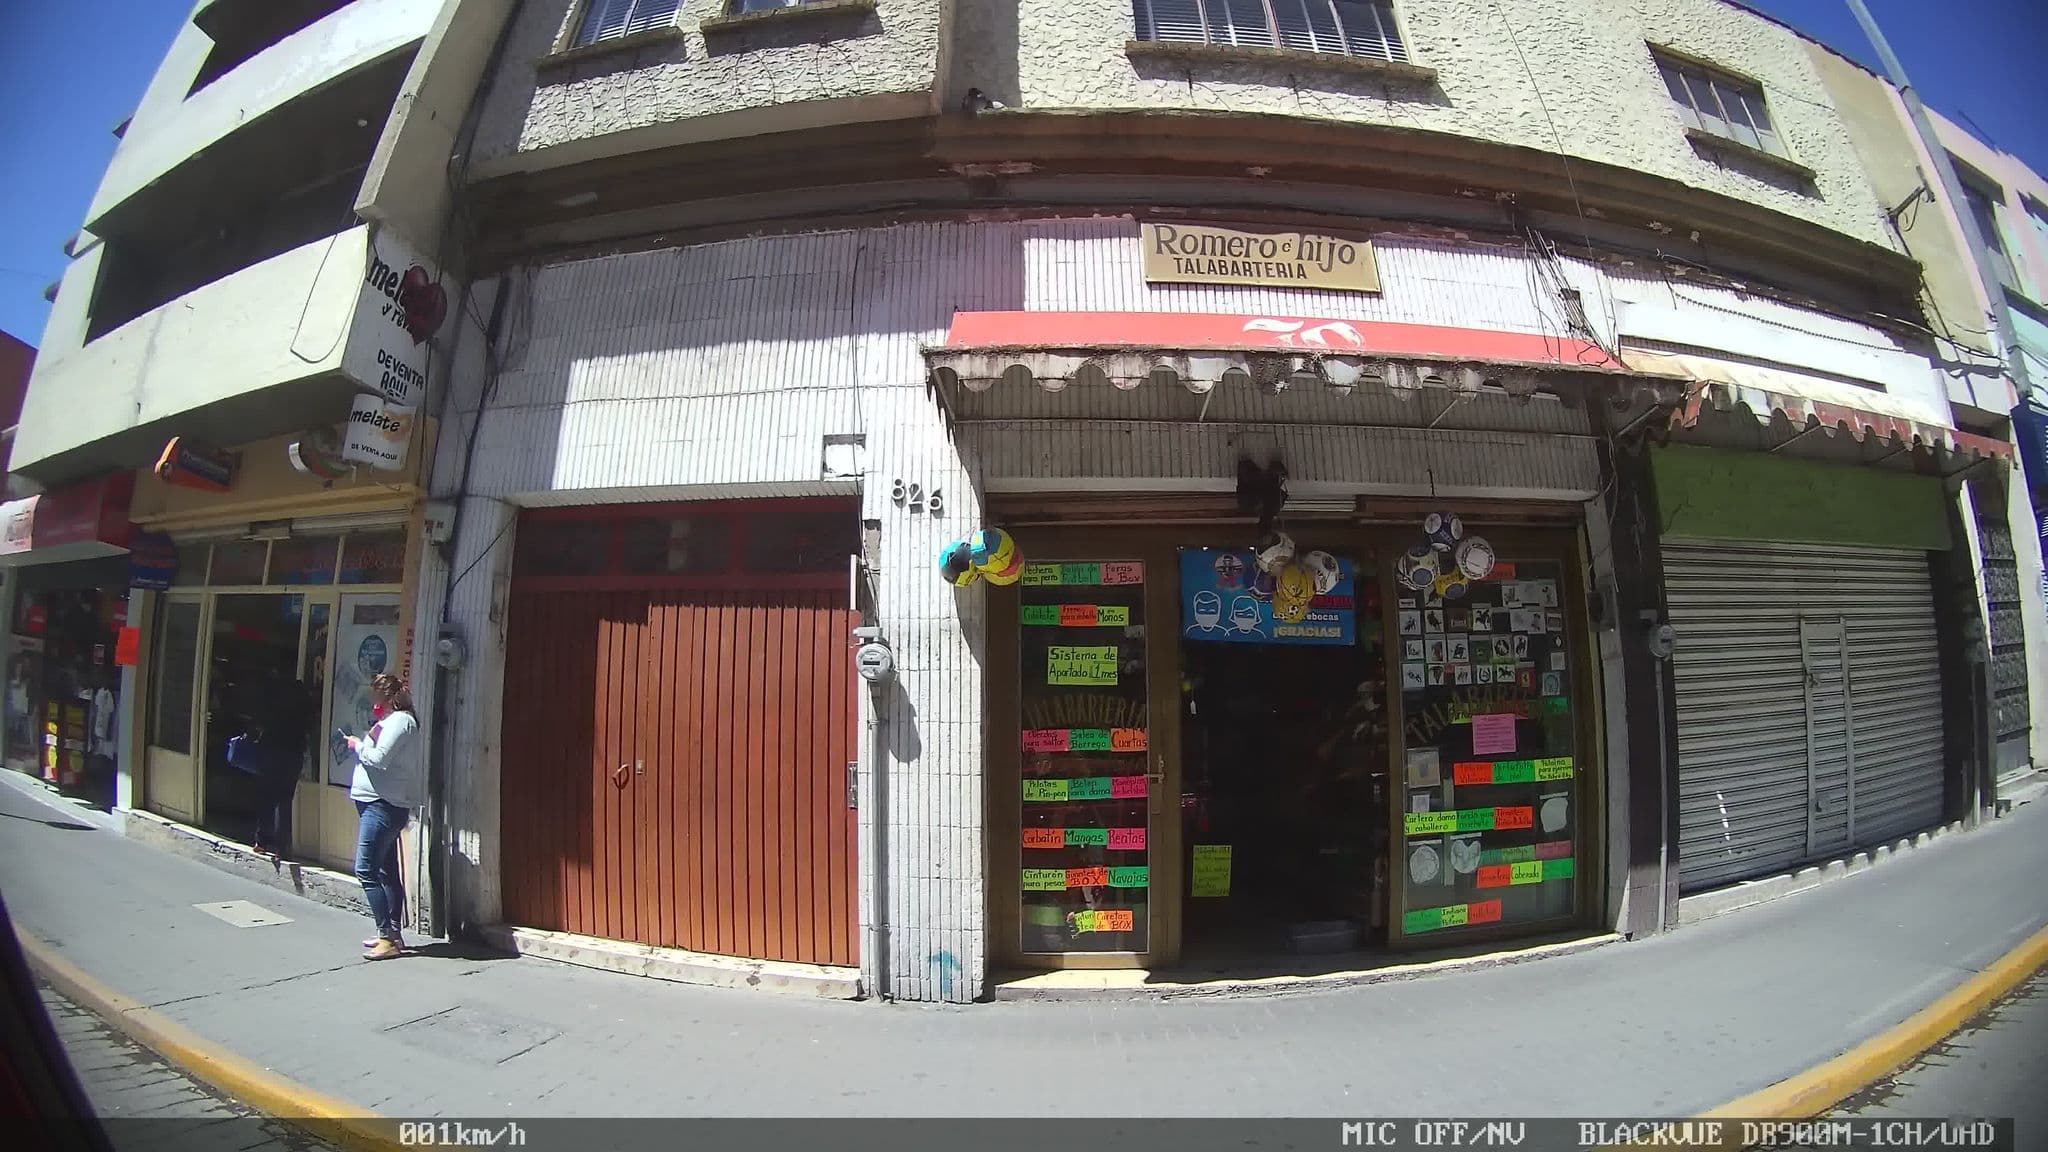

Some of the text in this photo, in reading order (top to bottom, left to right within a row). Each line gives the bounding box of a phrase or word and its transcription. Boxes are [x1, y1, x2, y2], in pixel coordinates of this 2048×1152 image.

[1153, 225, 1277, 257] Romero
[1295, 235, 1356, 273] hijo
[1173, 258, 1308, 280] TALABARTERIA
[350, 409, 400, 432] melate
[361, 444, 379, 456] VENTA
[892, 478, 943, 510] 826
[1273, 625, 1342, 638] ¡GRACIAS!
[1049, 644, 1116, 661] Sistema de
[1049, 662, 1088, 682] Apartado
[1101, 671, 1118, 679] mes
[1064, 829, 1103, 844] Mangas
[1072, 876, 1100, 886] BOX
[1109, 870, 1147, 886] Navajas
[1111, 920, 1131, 930] BOX
